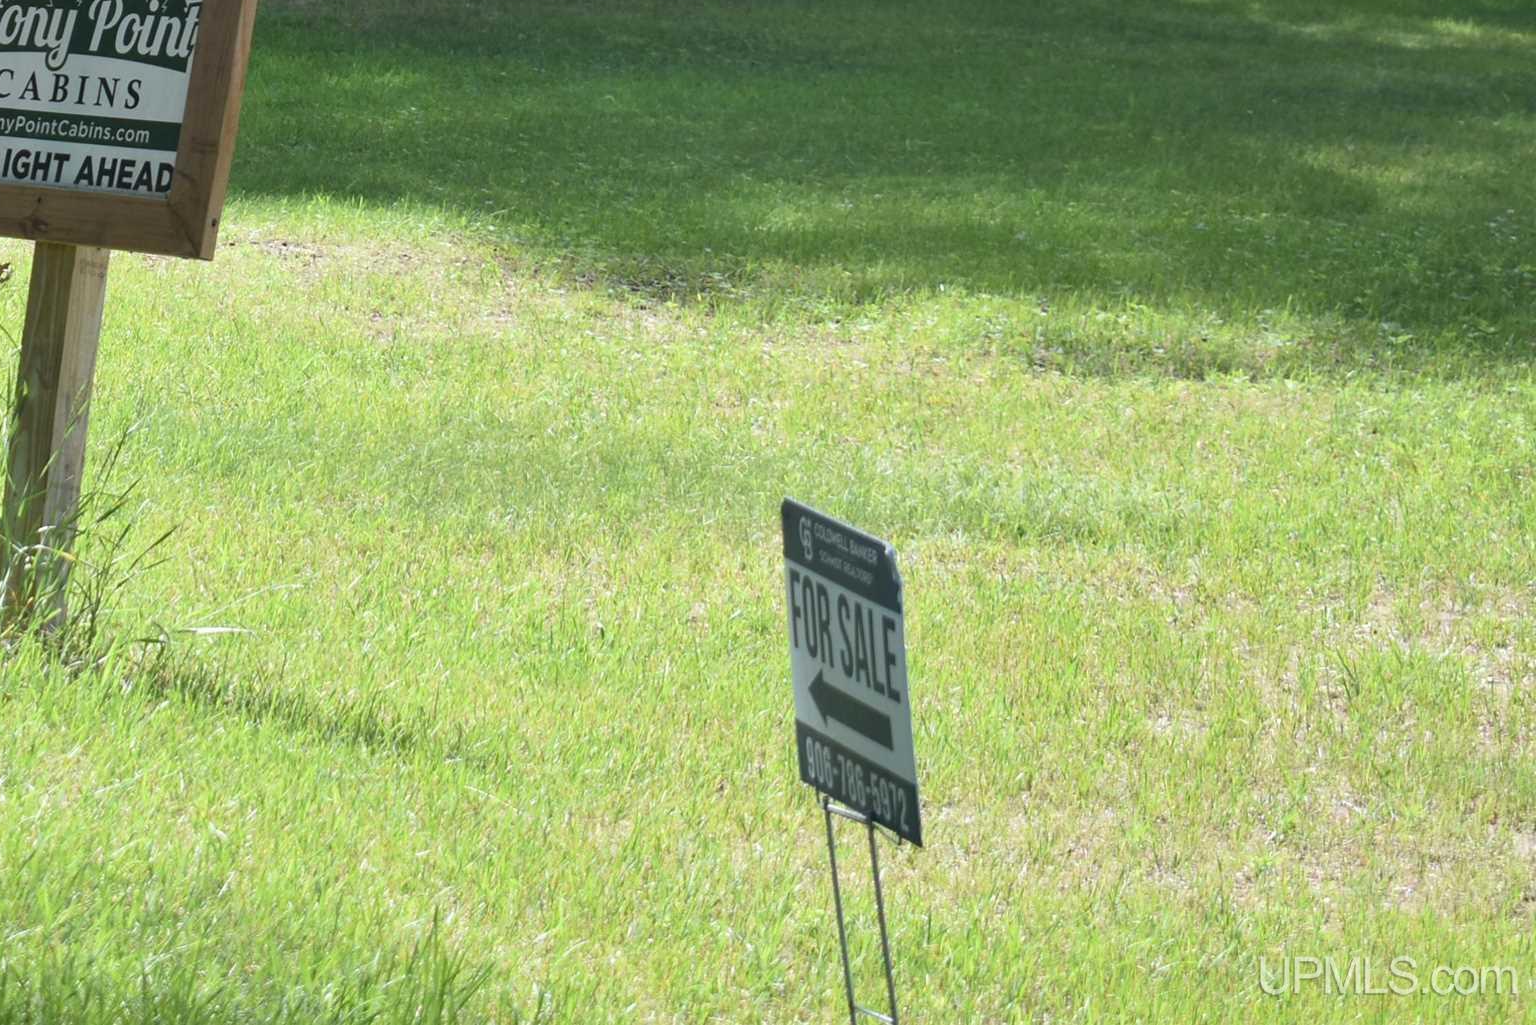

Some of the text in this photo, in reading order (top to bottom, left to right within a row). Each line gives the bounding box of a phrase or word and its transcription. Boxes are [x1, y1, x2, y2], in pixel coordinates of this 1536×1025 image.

[73, 155, 175, 194] AHEAD
[789, 568, 901, 703] FOR SALE
